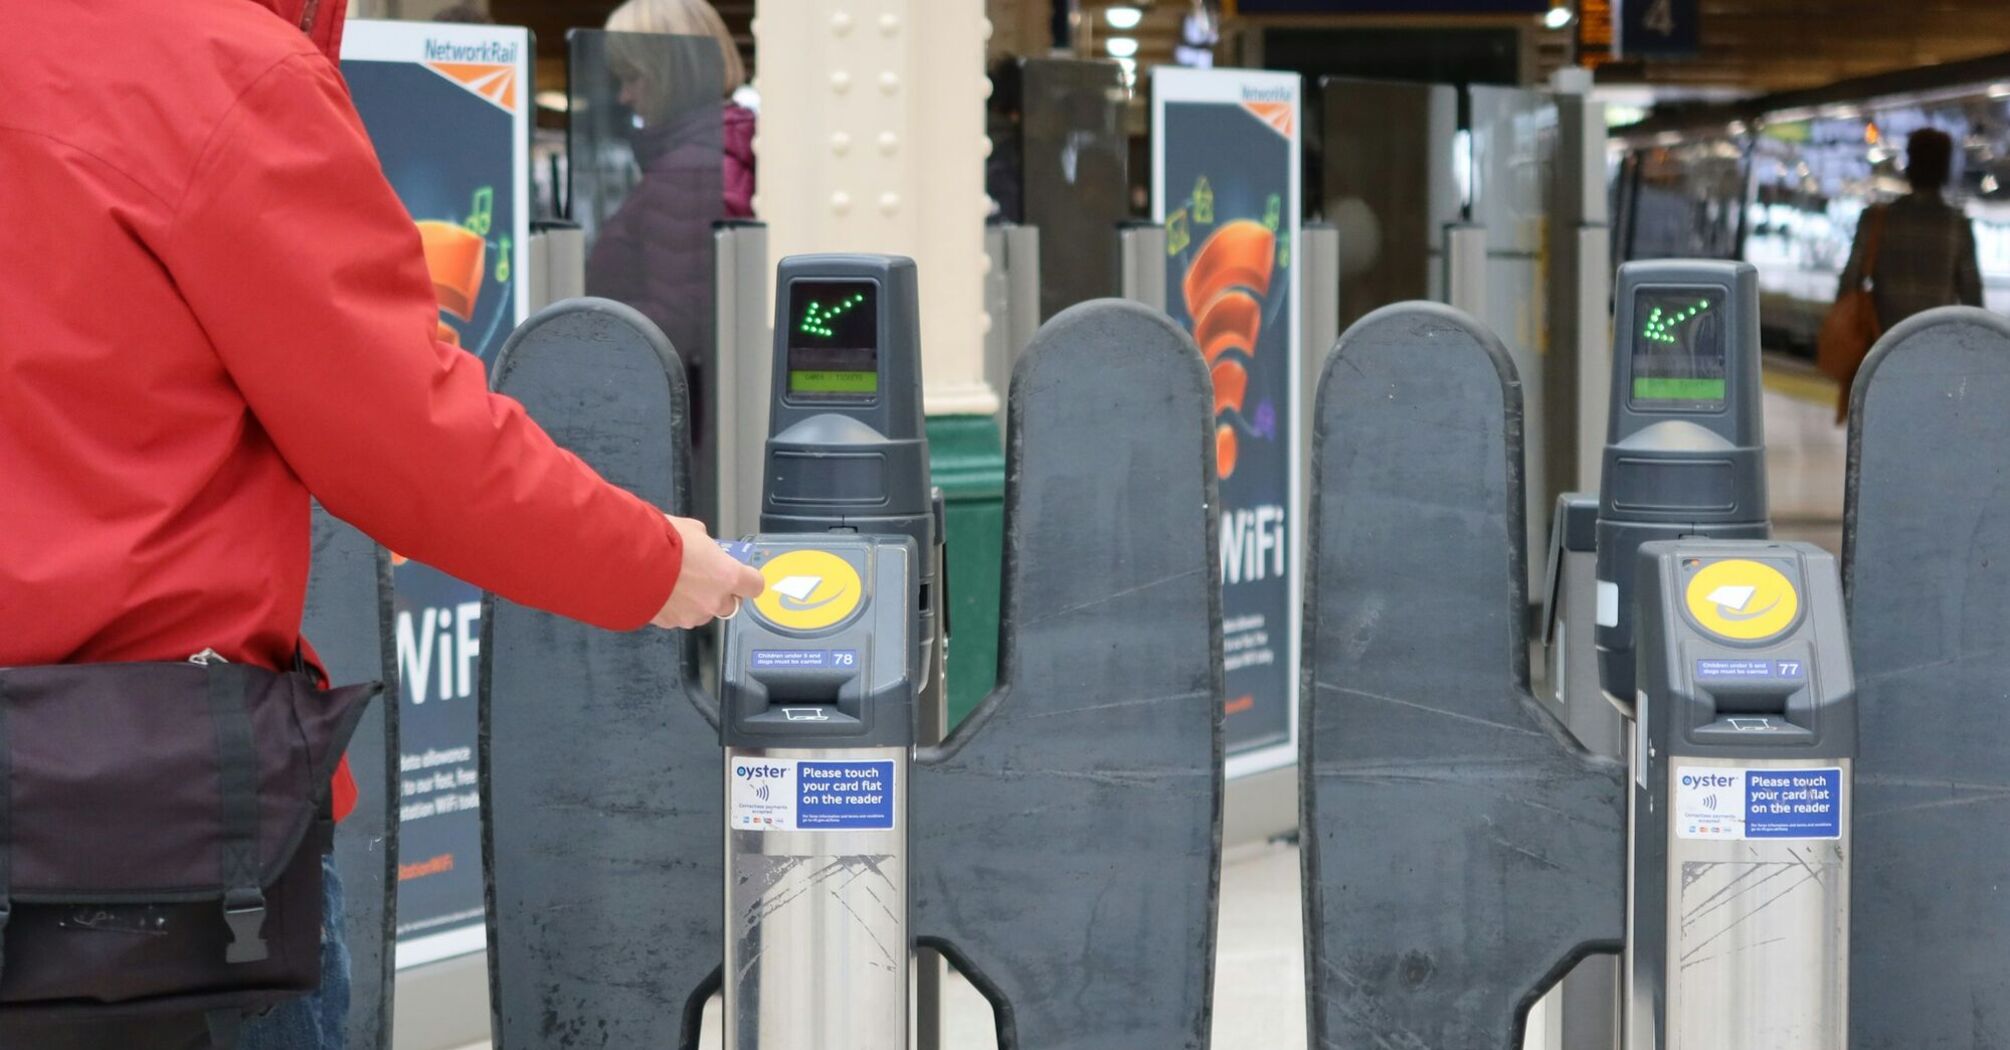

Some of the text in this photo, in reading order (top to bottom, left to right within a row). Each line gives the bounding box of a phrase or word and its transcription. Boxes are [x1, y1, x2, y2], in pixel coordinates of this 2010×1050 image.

[1643, 0, 1673, 36] 4
[1219, 505, 1284, 585] WiFi
[396, 602, 481, 705] WiF
[833, 653, 853, 665] 78
[1779, 663, 1798, 675] 77
[737, 765, 787, 780] oyster
[803, 767, 879, 778] Please touch
[803, 780, 882, 794] your card flat
[1682, 774, 1735, 790] oyster
[1751, 776, 1826, 787] Please touch
[803, 794, 883, 804] on the reader
[1751, 791, 1779, 802] your
[1782, 789, 1807, 800] card
[1751, 802, 1830, 813] on the reader
